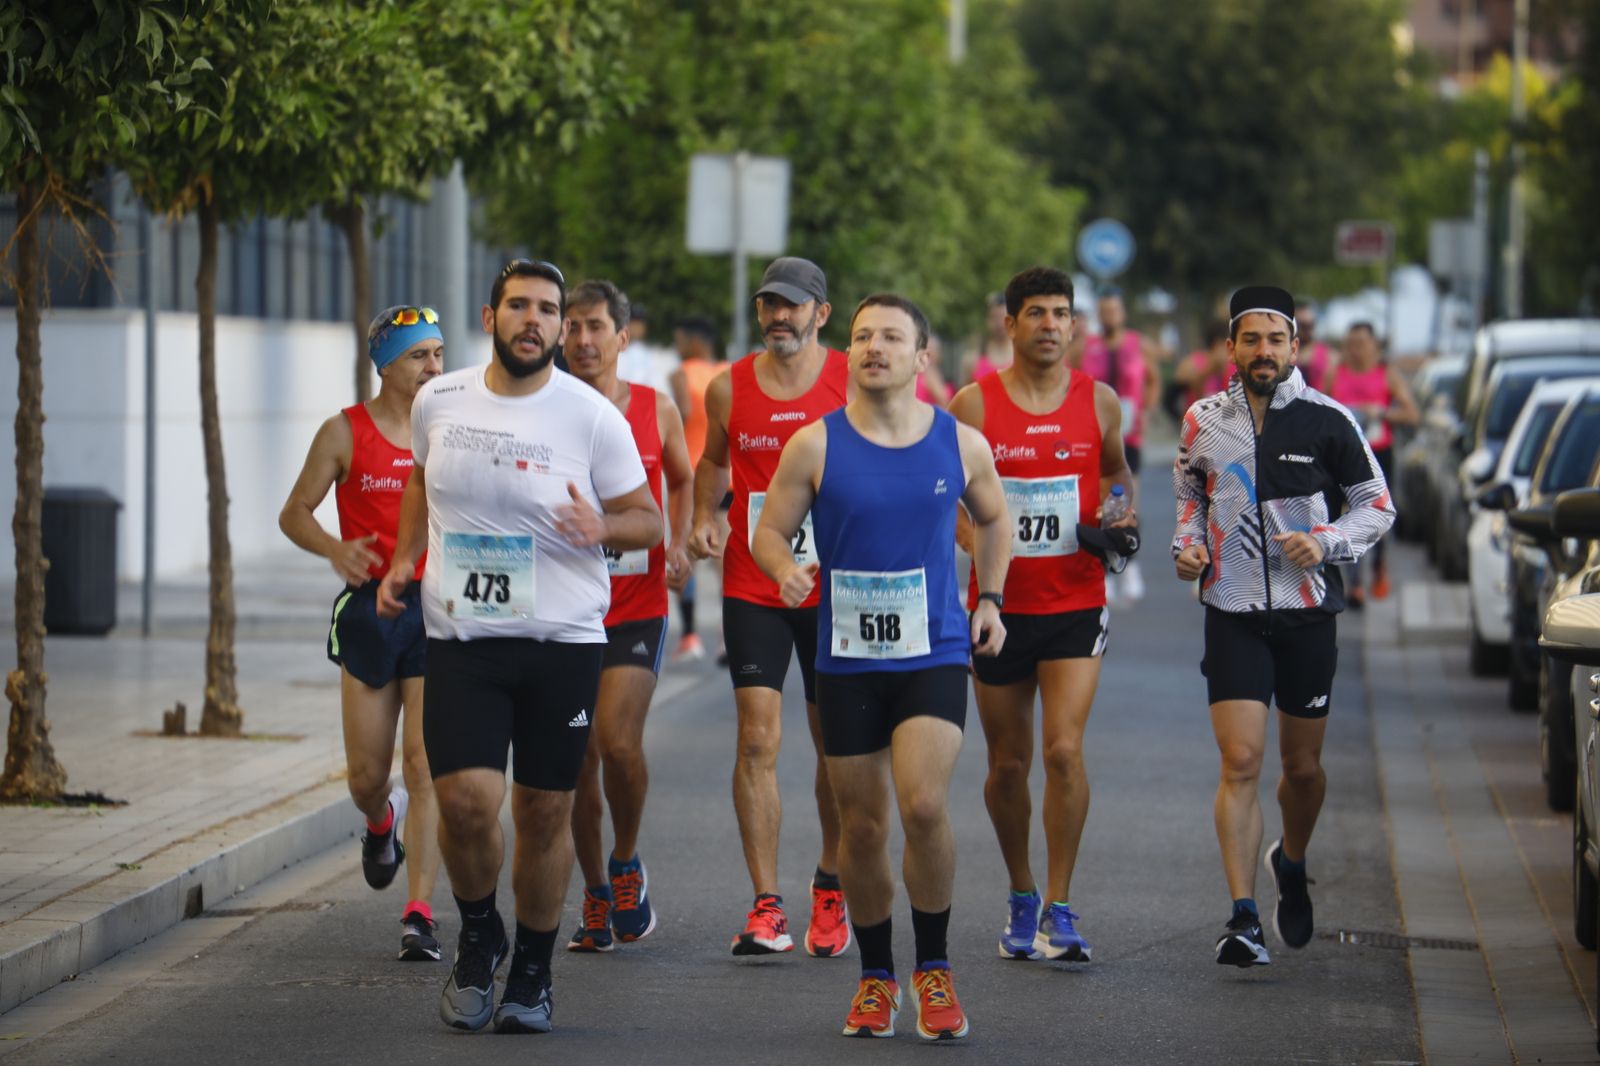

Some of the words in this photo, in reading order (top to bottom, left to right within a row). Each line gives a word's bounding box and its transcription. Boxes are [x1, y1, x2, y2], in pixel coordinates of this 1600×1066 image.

[1003, 445, 1036, 458] califas
[1287, 454, 1315, 463] TERREX
[370, 477, 402, 489] califas
[463, 572, 510, 604] 473
[836, 587, 868, 600] MEDIA
[859, 613, 901, 642] 518
